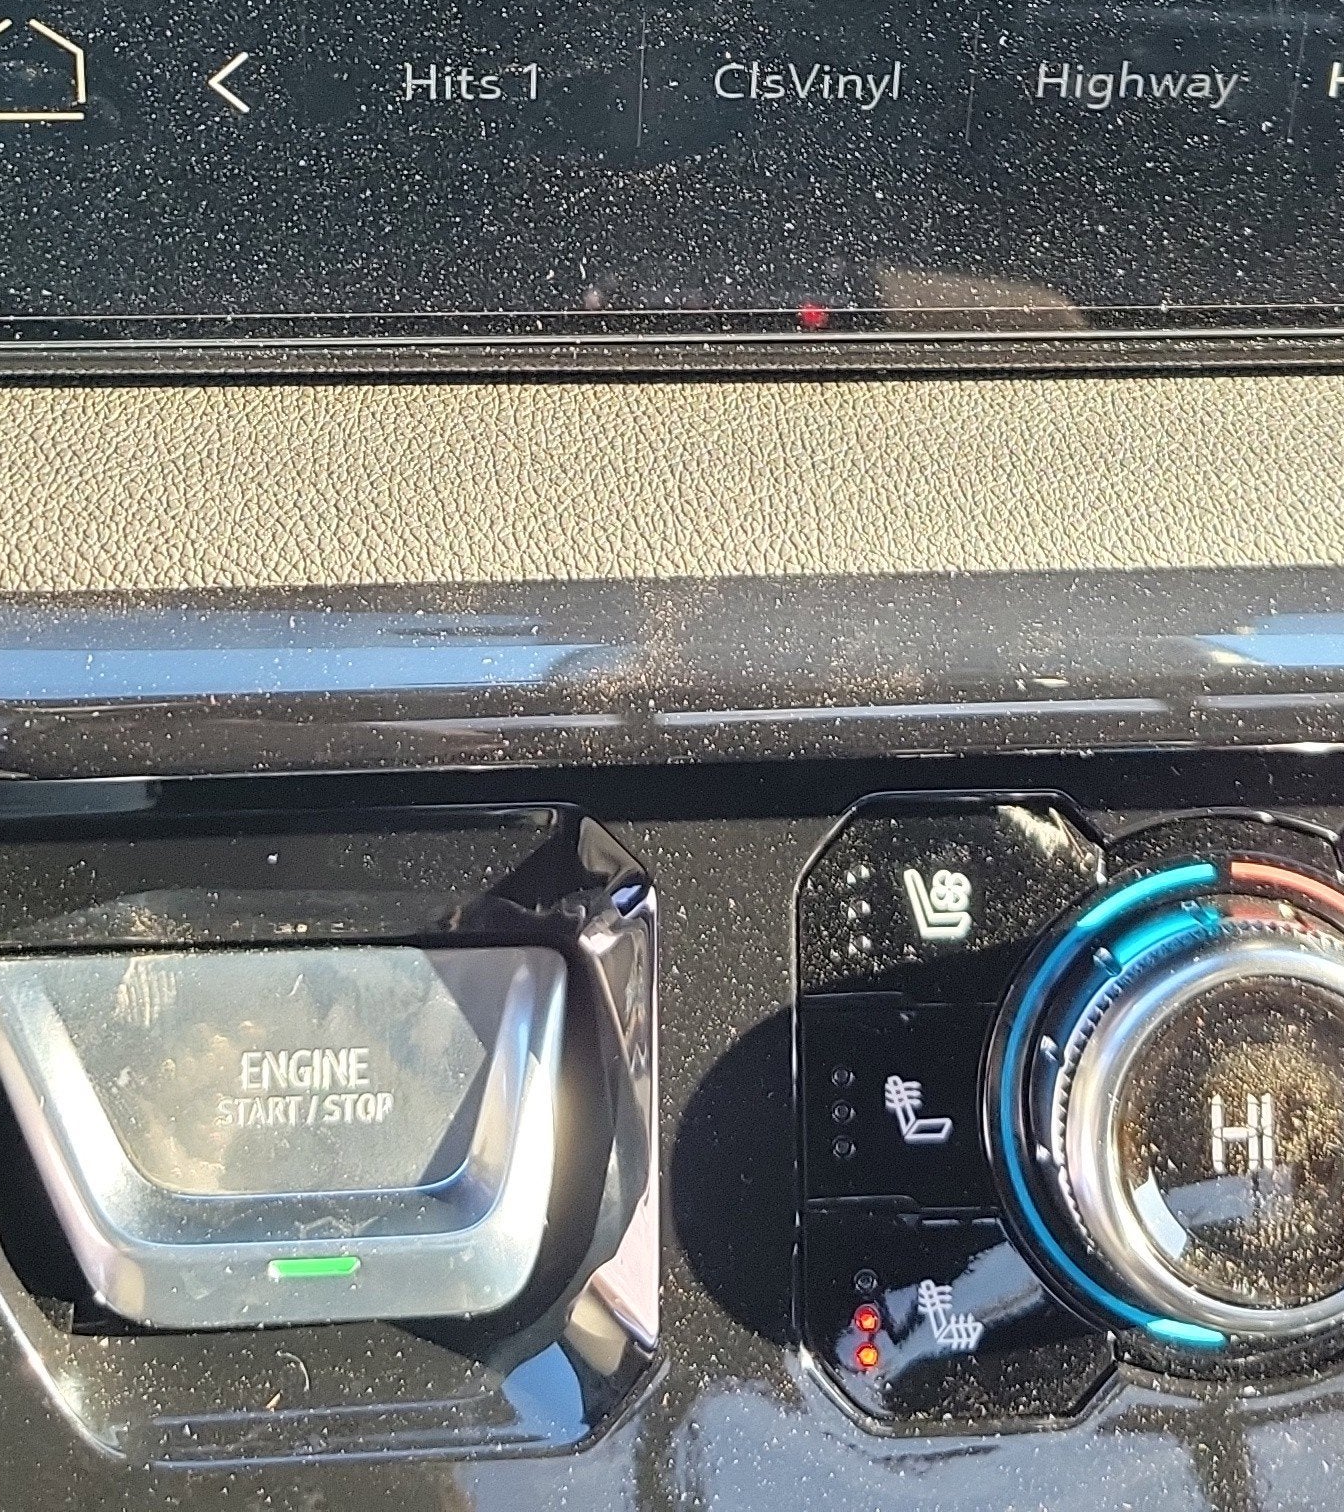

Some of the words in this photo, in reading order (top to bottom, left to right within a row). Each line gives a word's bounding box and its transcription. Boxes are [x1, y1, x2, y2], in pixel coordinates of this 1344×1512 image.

[404, 63, 502, 101] Hits
[524, 63, 540, 100] 1
[713, 62, 902, 111] ClsVinyl
[1035, 62, 1238, 111] Highway
[240, 1049, 371, 1088] ENGINE
[1211, 1093, 1274, 1172] HI
